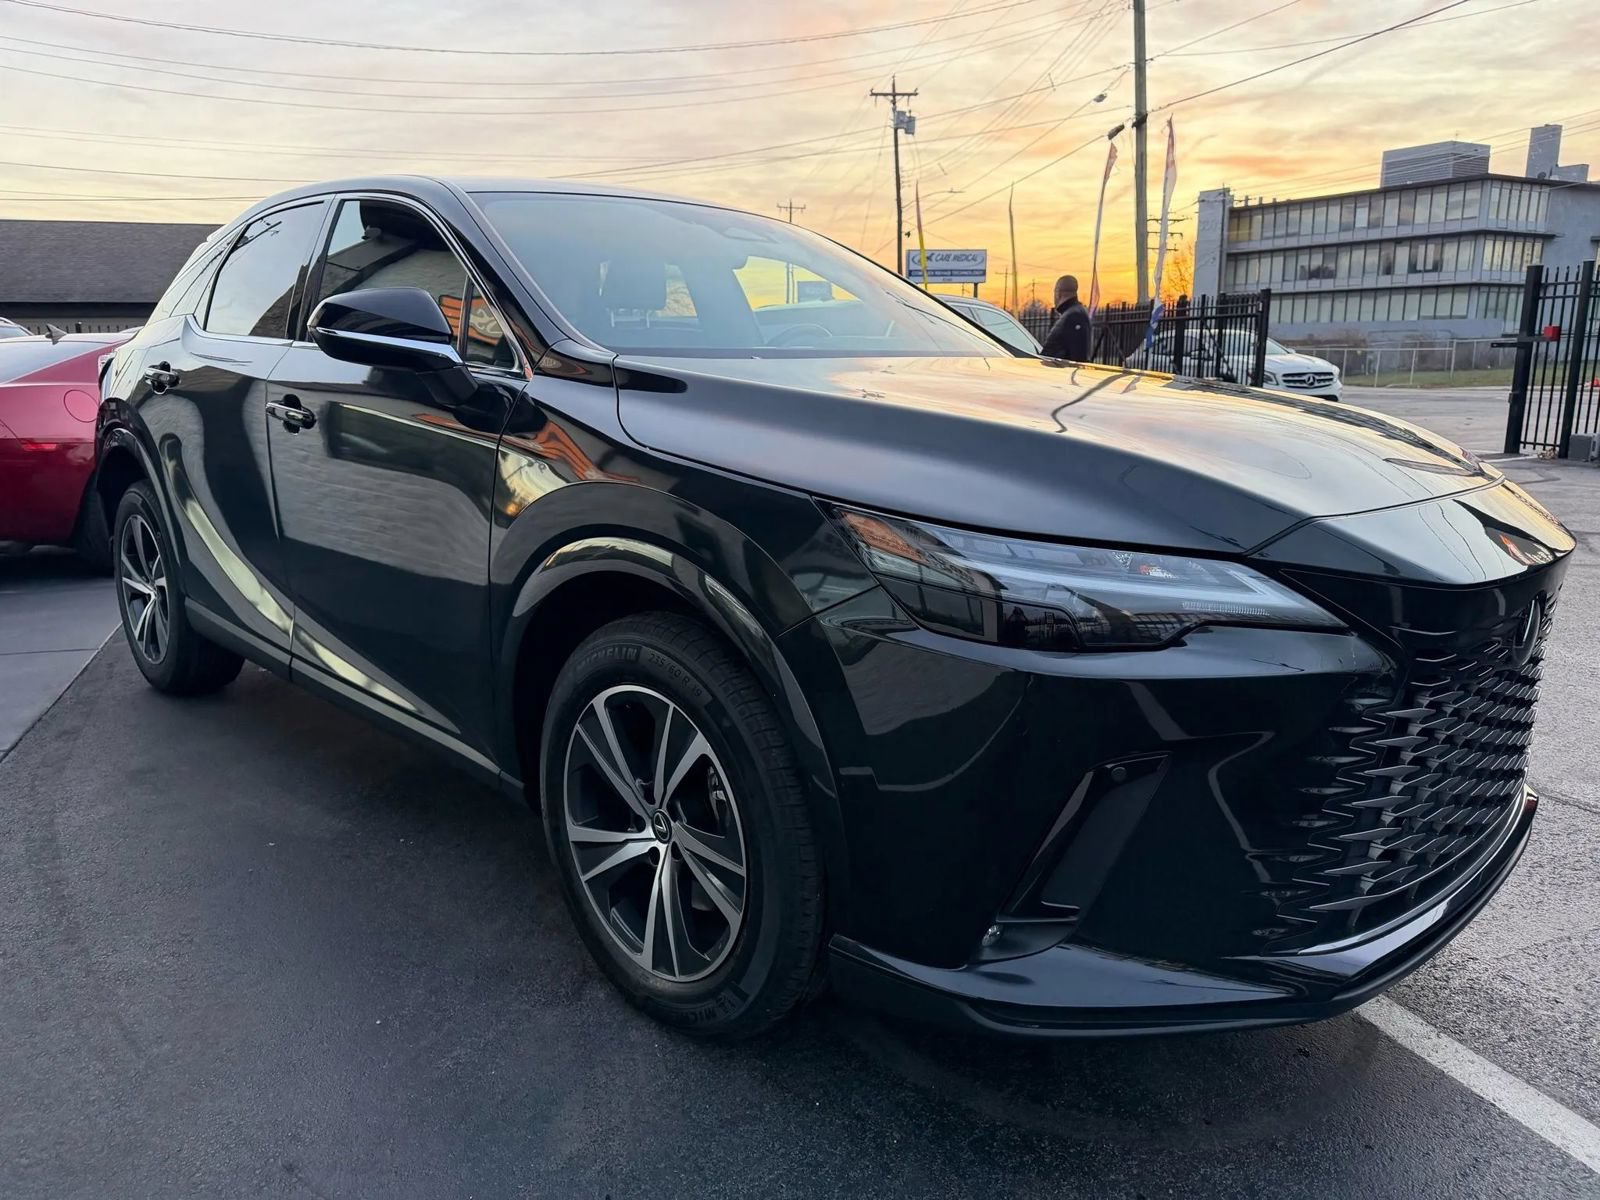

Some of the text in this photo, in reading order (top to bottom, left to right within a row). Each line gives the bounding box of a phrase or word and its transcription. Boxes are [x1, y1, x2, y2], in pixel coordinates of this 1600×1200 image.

[935, 253, 952, 262] CARE
[952, 253, 978, 262] MEDICAL
[680, 676, 690, 688] R
